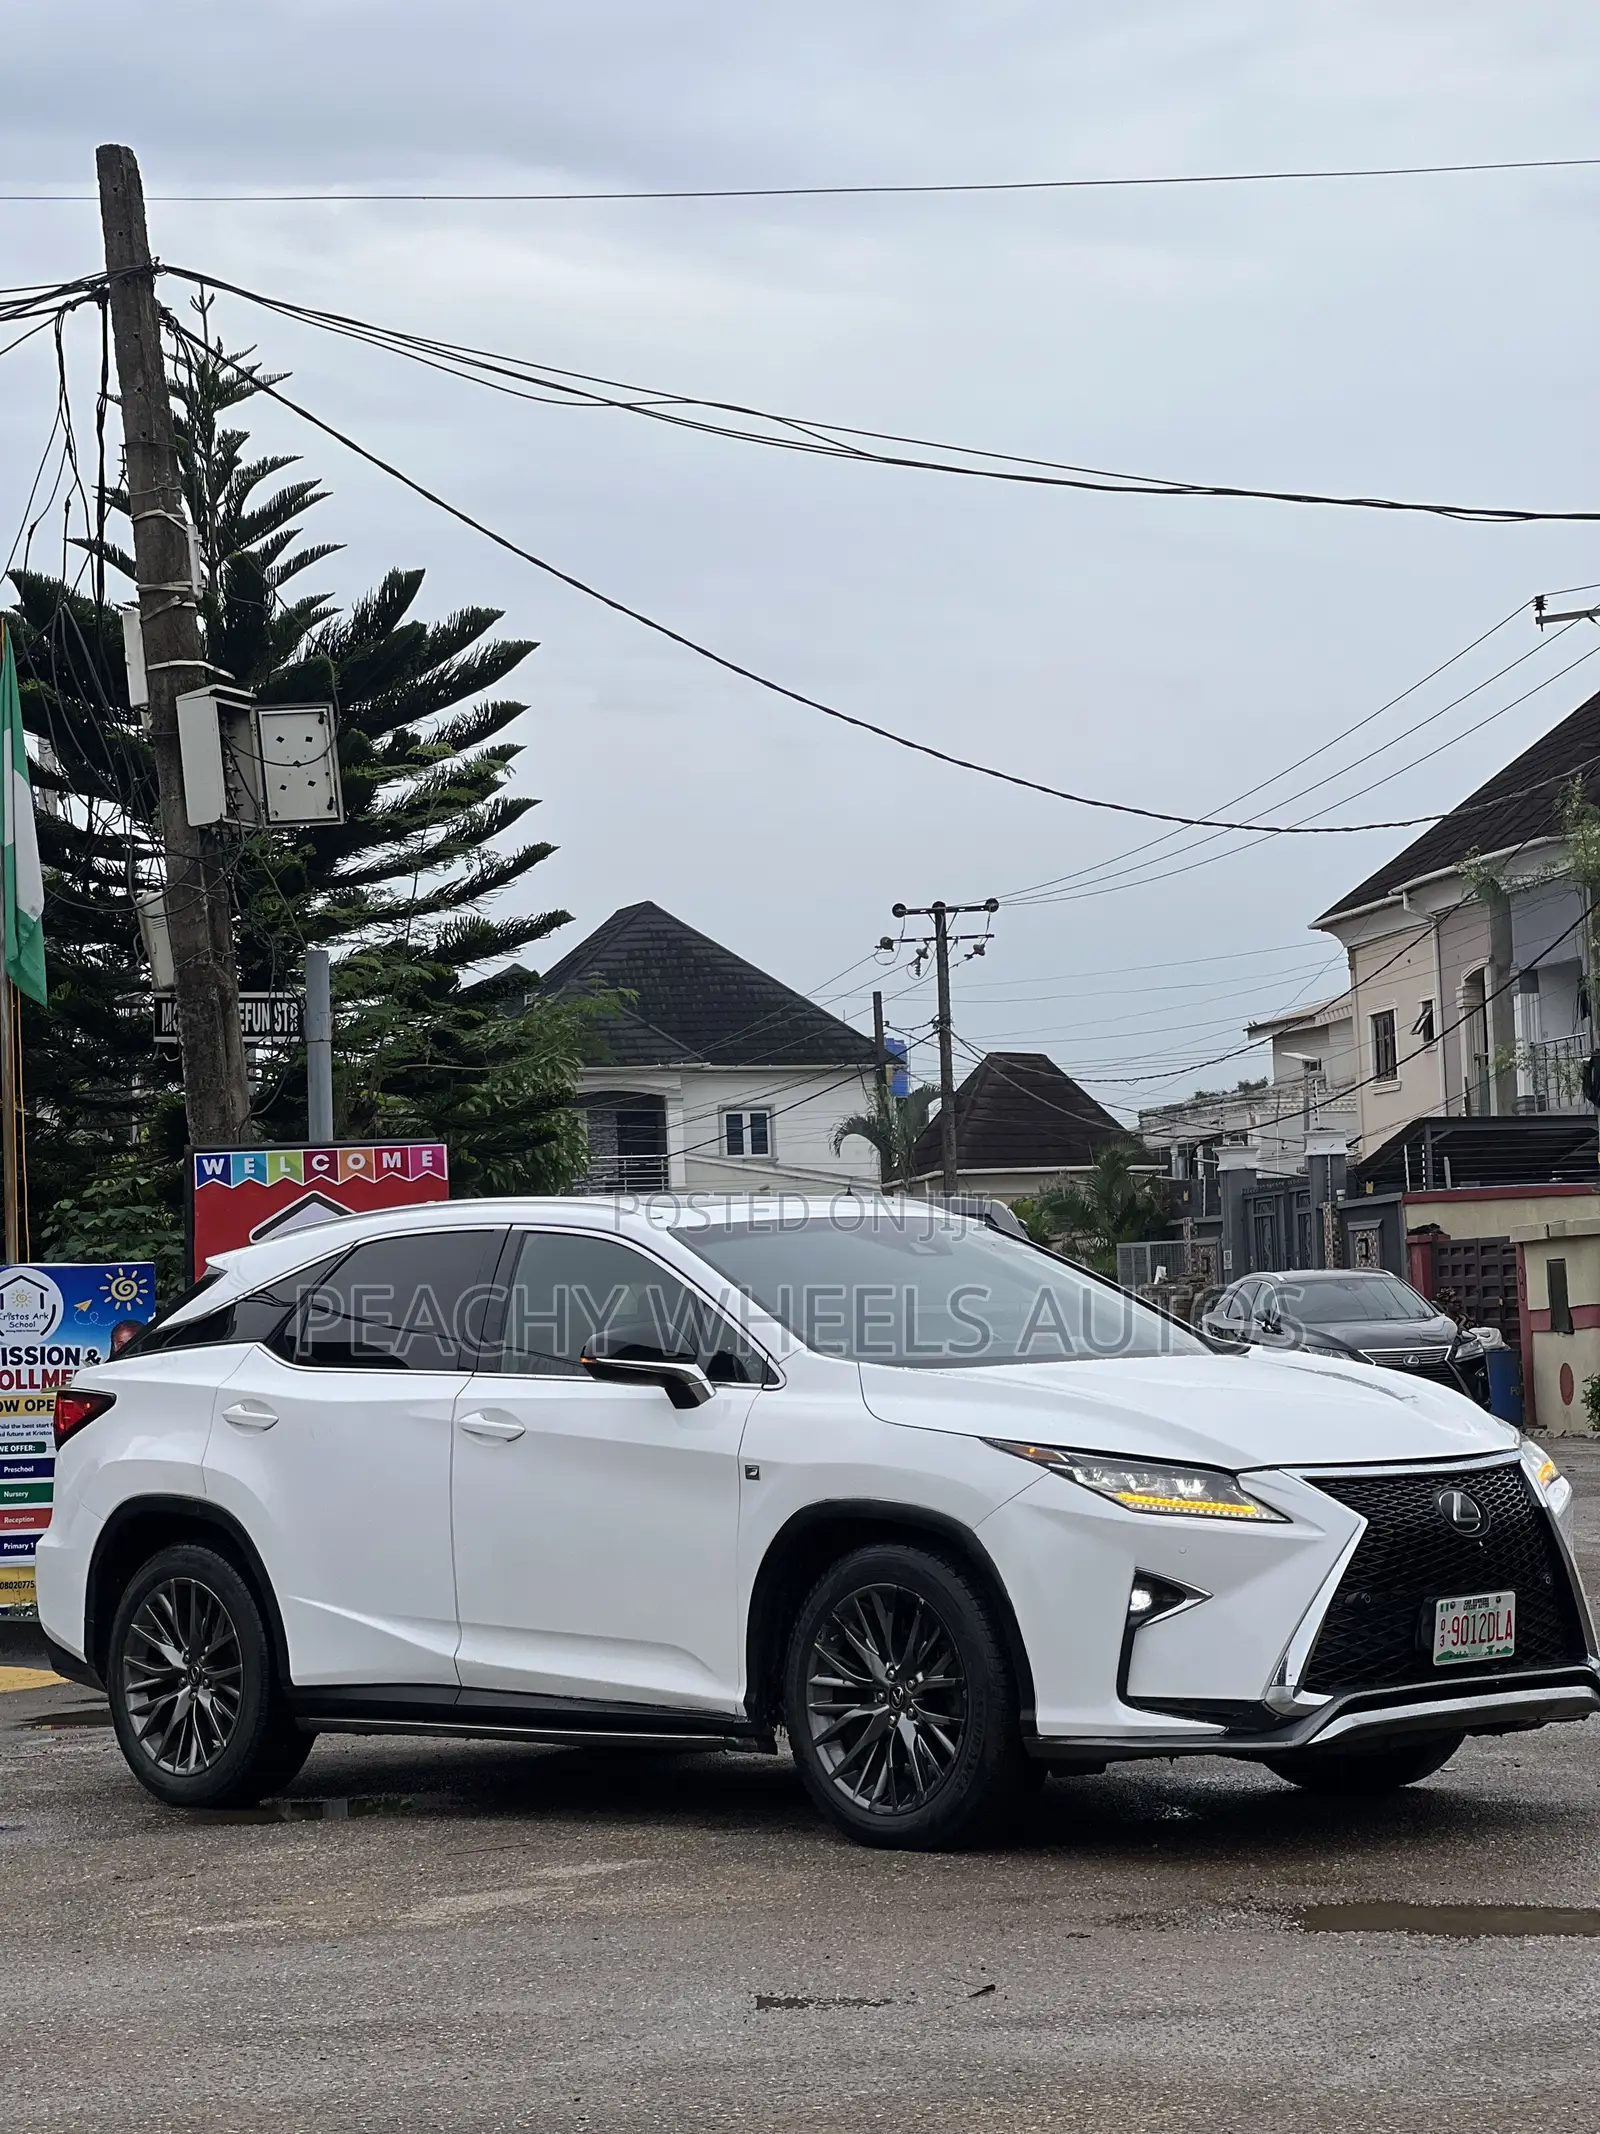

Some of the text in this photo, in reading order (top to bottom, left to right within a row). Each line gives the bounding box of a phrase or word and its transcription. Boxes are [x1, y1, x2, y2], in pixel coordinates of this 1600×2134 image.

[202, 1150, 434, 1175] WELCOME
[33, 1312, 49, 1320] Ark
[9, 1321, 36, 1329] School
[85, 1349, 101, 1365] &
[0, 1369, 80, 1391] OLLME
[10, 1444, 36, 1452] OFFER:
[3, 1465, 34, 1473] Preschool
[3, 1491, 29, 1499] Nursery
[4, 1516, 35, 1524] Reception
[3, 1542, 29, 1550] Primary
[1451, 1609, 1513, 1647] 9012DLA
